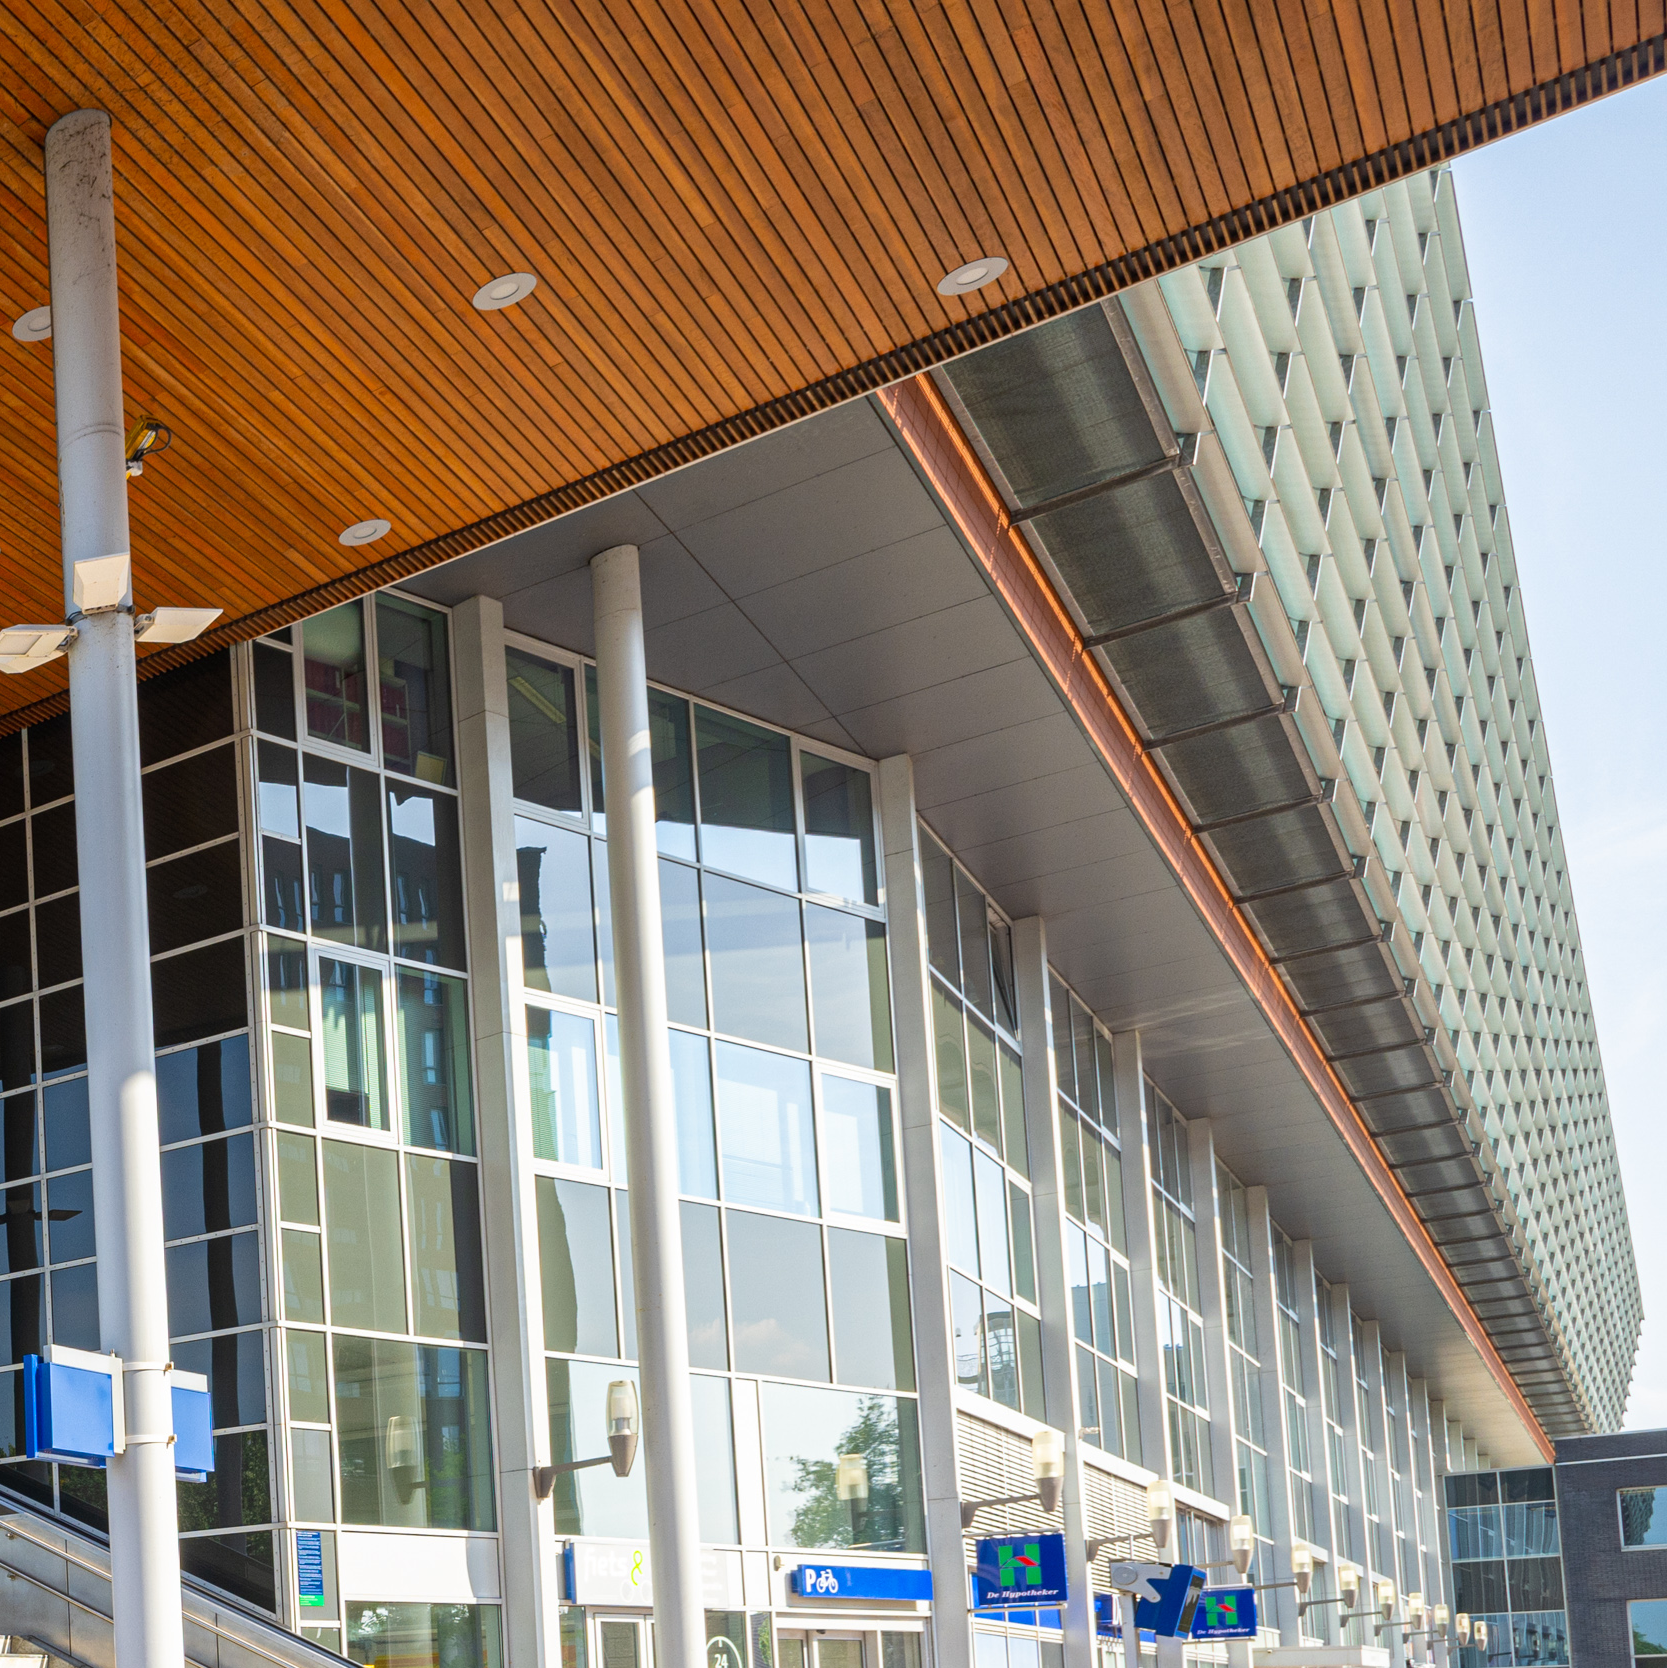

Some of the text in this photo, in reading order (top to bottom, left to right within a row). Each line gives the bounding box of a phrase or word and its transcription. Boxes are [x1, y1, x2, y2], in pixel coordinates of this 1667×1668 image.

[804, 1568, 817, 1593] P
[987, 1589, 1059, 1599] De Hypotheker
[1207, 1627, 1251, 1635] Hypotheker
[714, 1653, 729, 1668] 24
